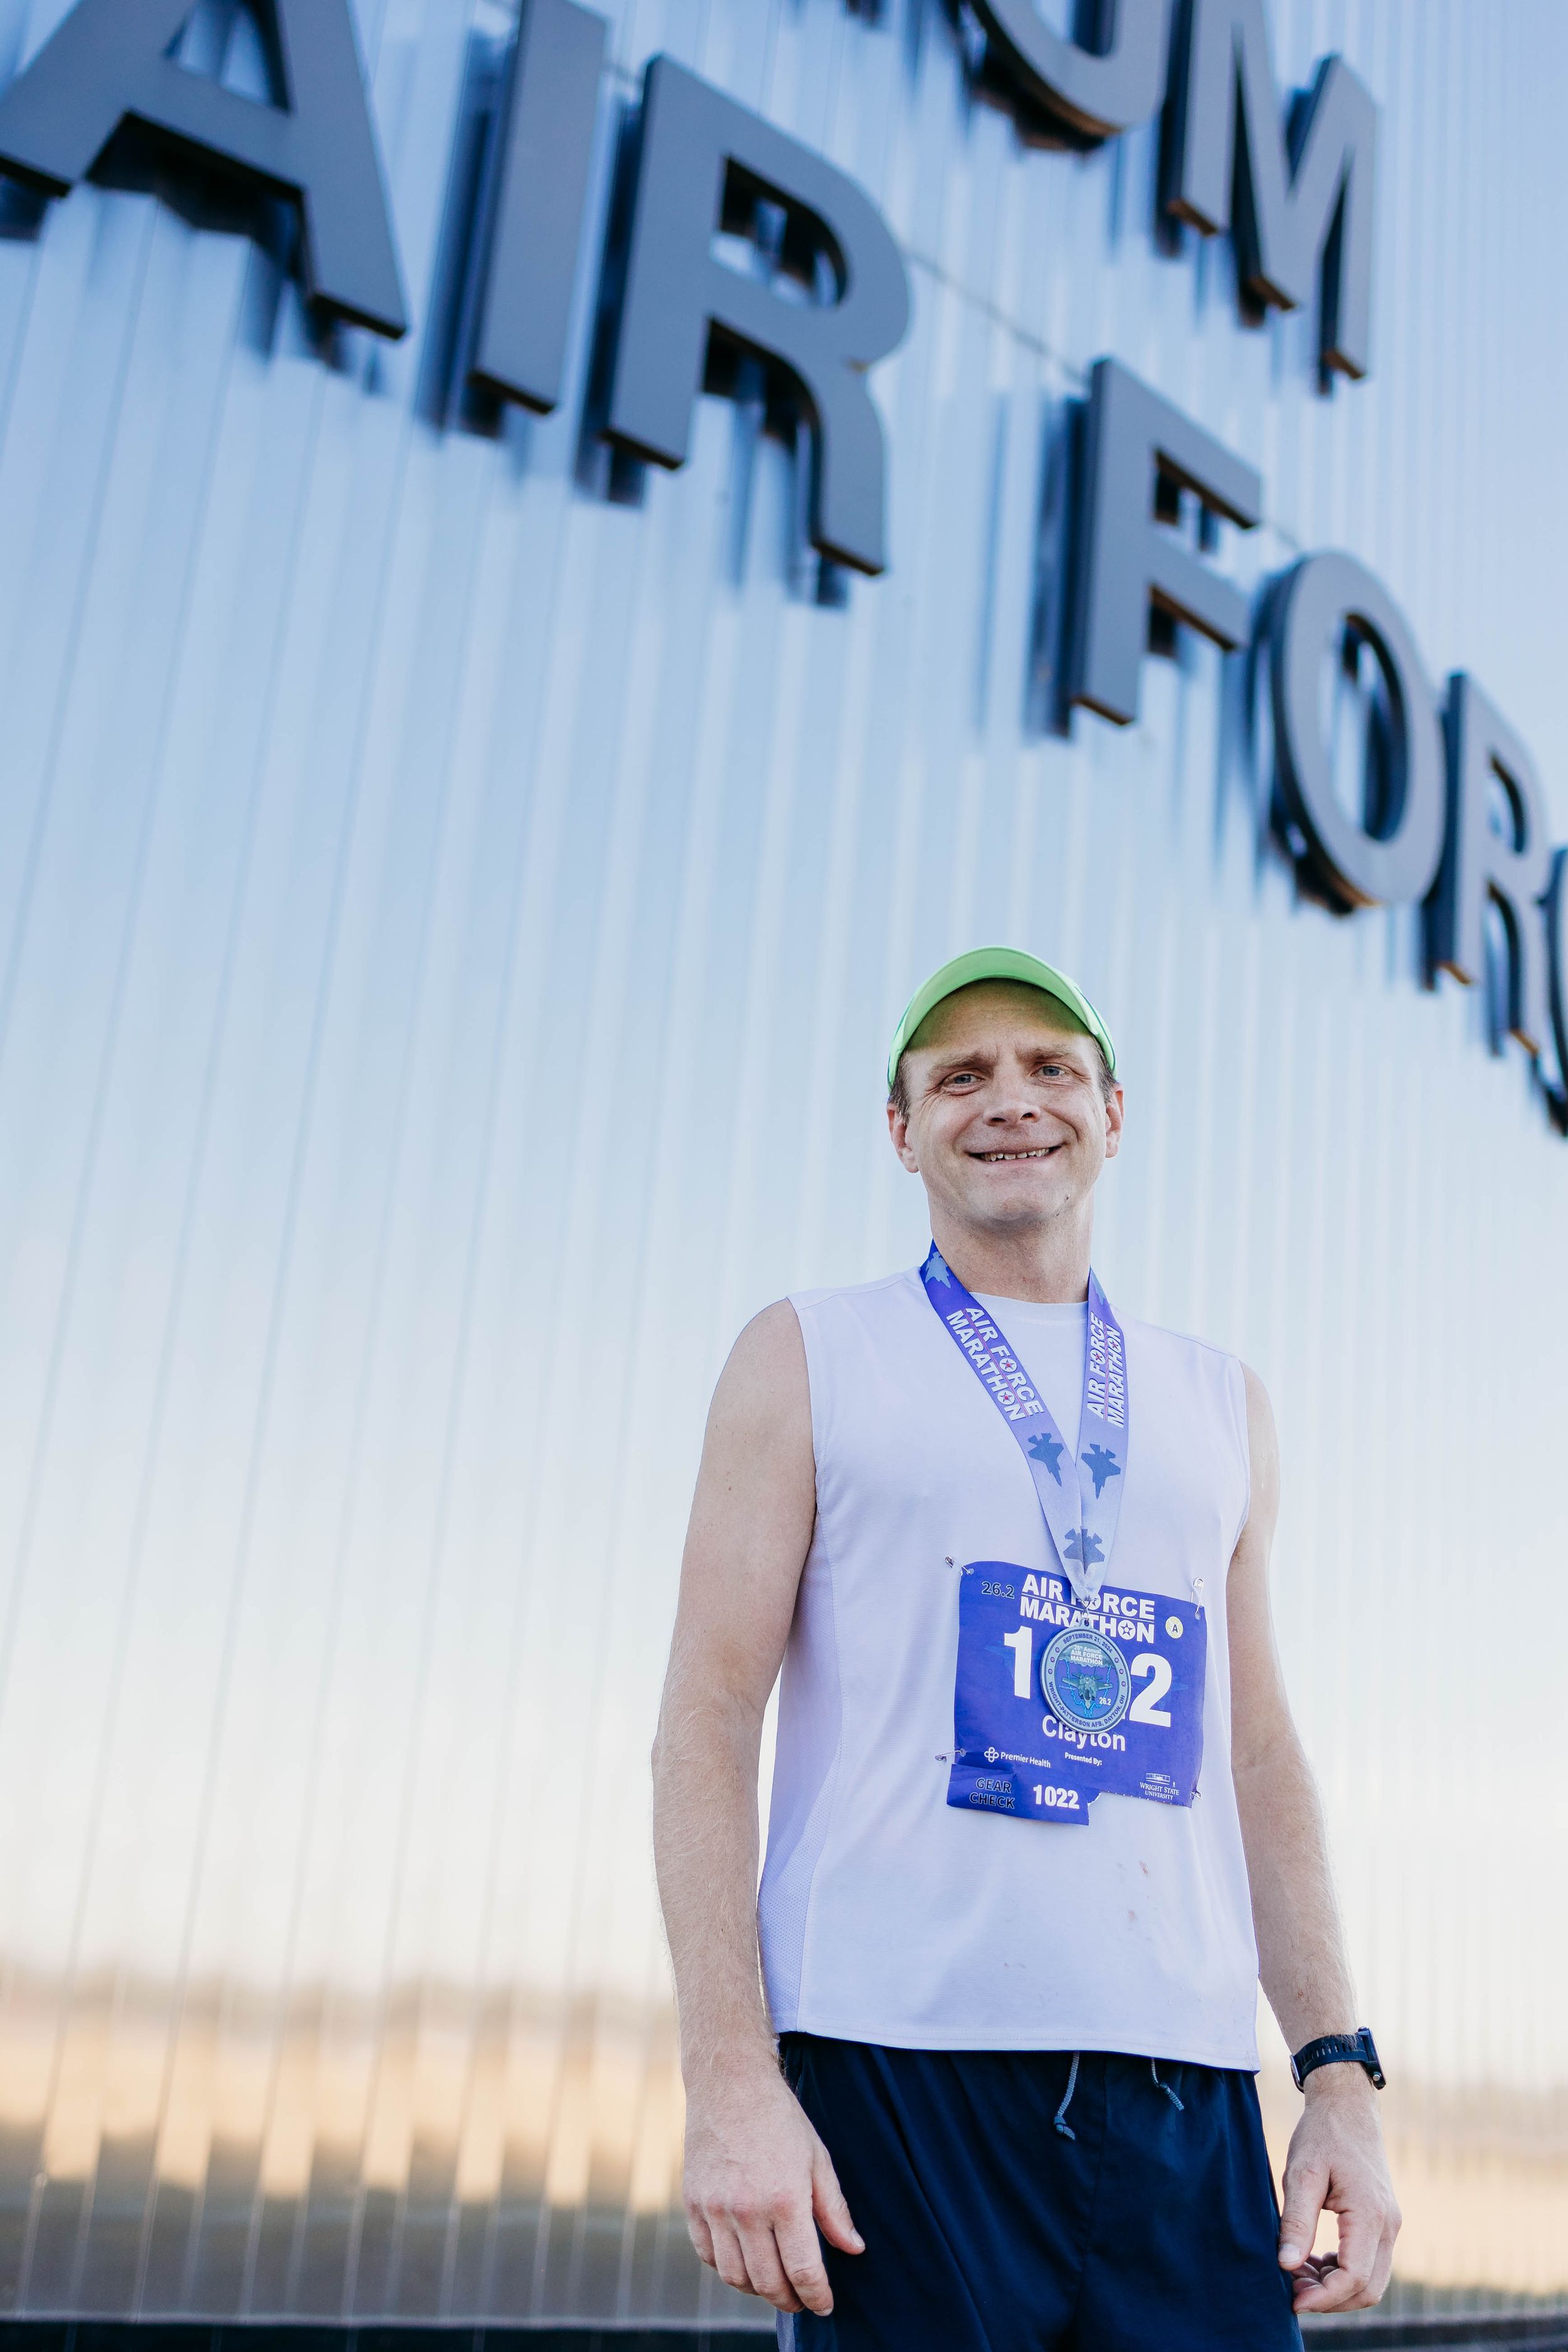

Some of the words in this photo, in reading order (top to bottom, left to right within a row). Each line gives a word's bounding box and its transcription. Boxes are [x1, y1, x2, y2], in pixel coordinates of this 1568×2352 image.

[0, 0, 913, 575] AIR
[1071, 356, 1568, 1094] FOR
[1089, 1311, 1106, 1377] FORCE
[946, 1310, 1027, 1421] MARATHON
[965, 1308, 999, 1342] AIR
[991, 1345, 1044, 1416] FORCE
[1106, 1323, 1125, 1428] MARATHON
[1087, 1378, 1106, 1419] AIR
[981, 1581, 1015, 1599] 26.2
[1022, 1574, 1063, 1602] AIR
[1020, 1596, 1155, 1644] MARATHON
[1172, 1624, 1178, 1633] A
[1062, 1633, 1093, 1644] SEPTEMBER
[1101, 1641, 1113, 1653] 2024
[1070, 1655, 1103, 1666] MARATHON
[1083, 1651, 1103, 1660] FORCE
[1004, 1626, 1172, 1727] 12
[1048, 1681, 1090, 1727] WRIGHT-PATTERSON
[1104, 1706, 1122, 1724] DAYTON,
[1119, 1695, 1125, 1704] OH
[1099, 1697, 1111, 1706] 26.2
[1042, 1715, 1125, 1751] Clayton
[1000, 1751, 1029, 1763] Premier
[1029, 1756, 1051, 1768] Health
[1065, 1752, 1092, 1764] Presented
[1093, 1757, 1103, 1766] By:
[975, 1776, 1012, 1794] GEAR
[1140, 1782, 1163, 1792] WRIGHT
[1163, 1786, 1179, 1795] STATE
[1145, 1790, 1173, 1800] UNIVERSITY
[968, 1791, 1015, 1809] CHECK
[1032, 1784, 1079, 1809] 1022
